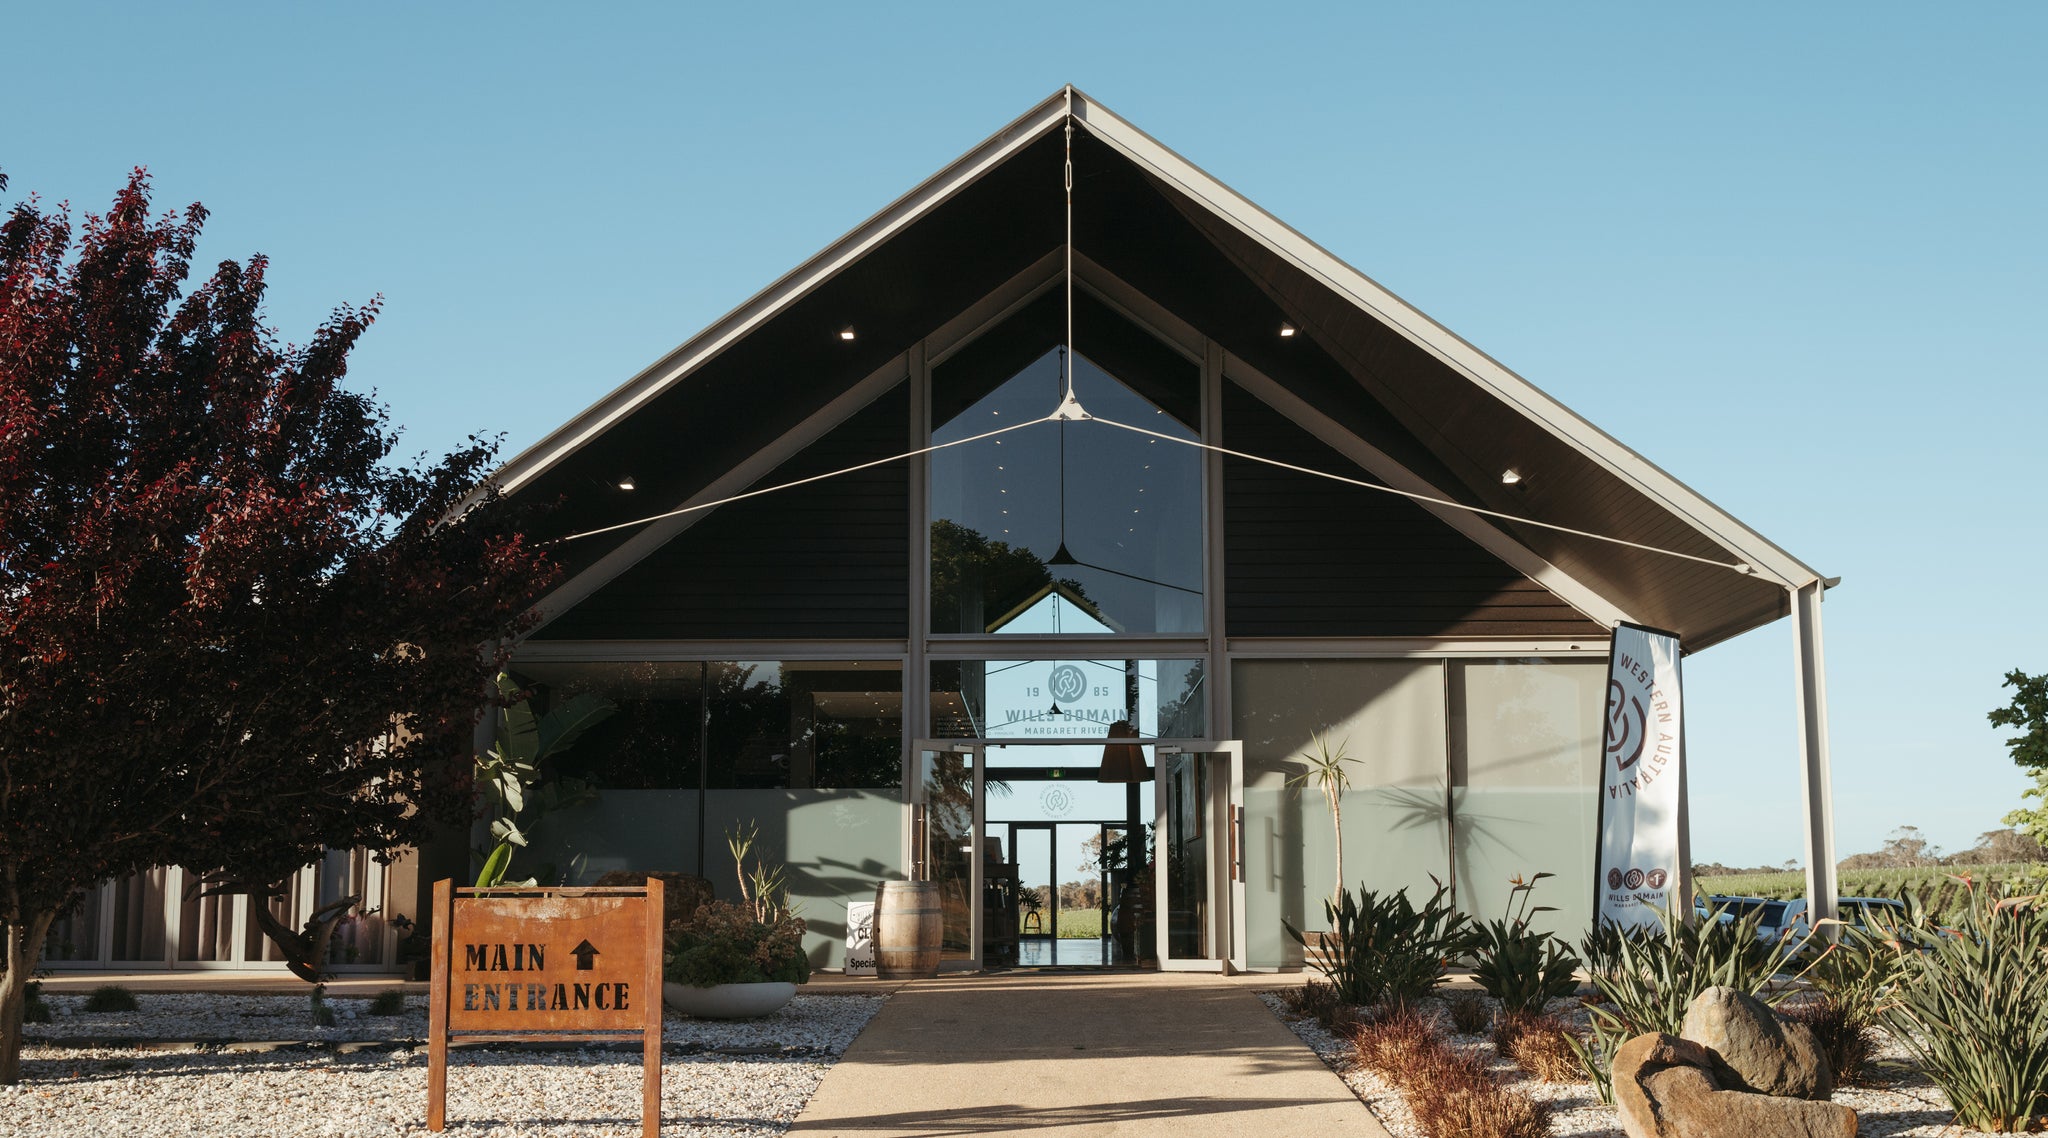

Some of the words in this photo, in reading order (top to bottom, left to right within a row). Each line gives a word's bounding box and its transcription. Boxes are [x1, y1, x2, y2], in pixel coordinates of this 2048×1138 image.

[1026, 687, 1040, 697] 19
[1093, 686, 1109, 697] 85
[1620, 652, 1673, 723] WESTERN
[1005, 709, 1055, 722] WILLS
[1063, 708, 1129, 722] DOMAIN
[1024, 727, 1077, 735] MARGARET
[1080, 726, 1109, 735] RIVER
[1609, 732, 1674, 799] AUSTRALIA
[465, 944, 546, 971] MAIN
[850, 958, 877, 970] Specia
[463, 982, 630, 1011] ENTRANCE
